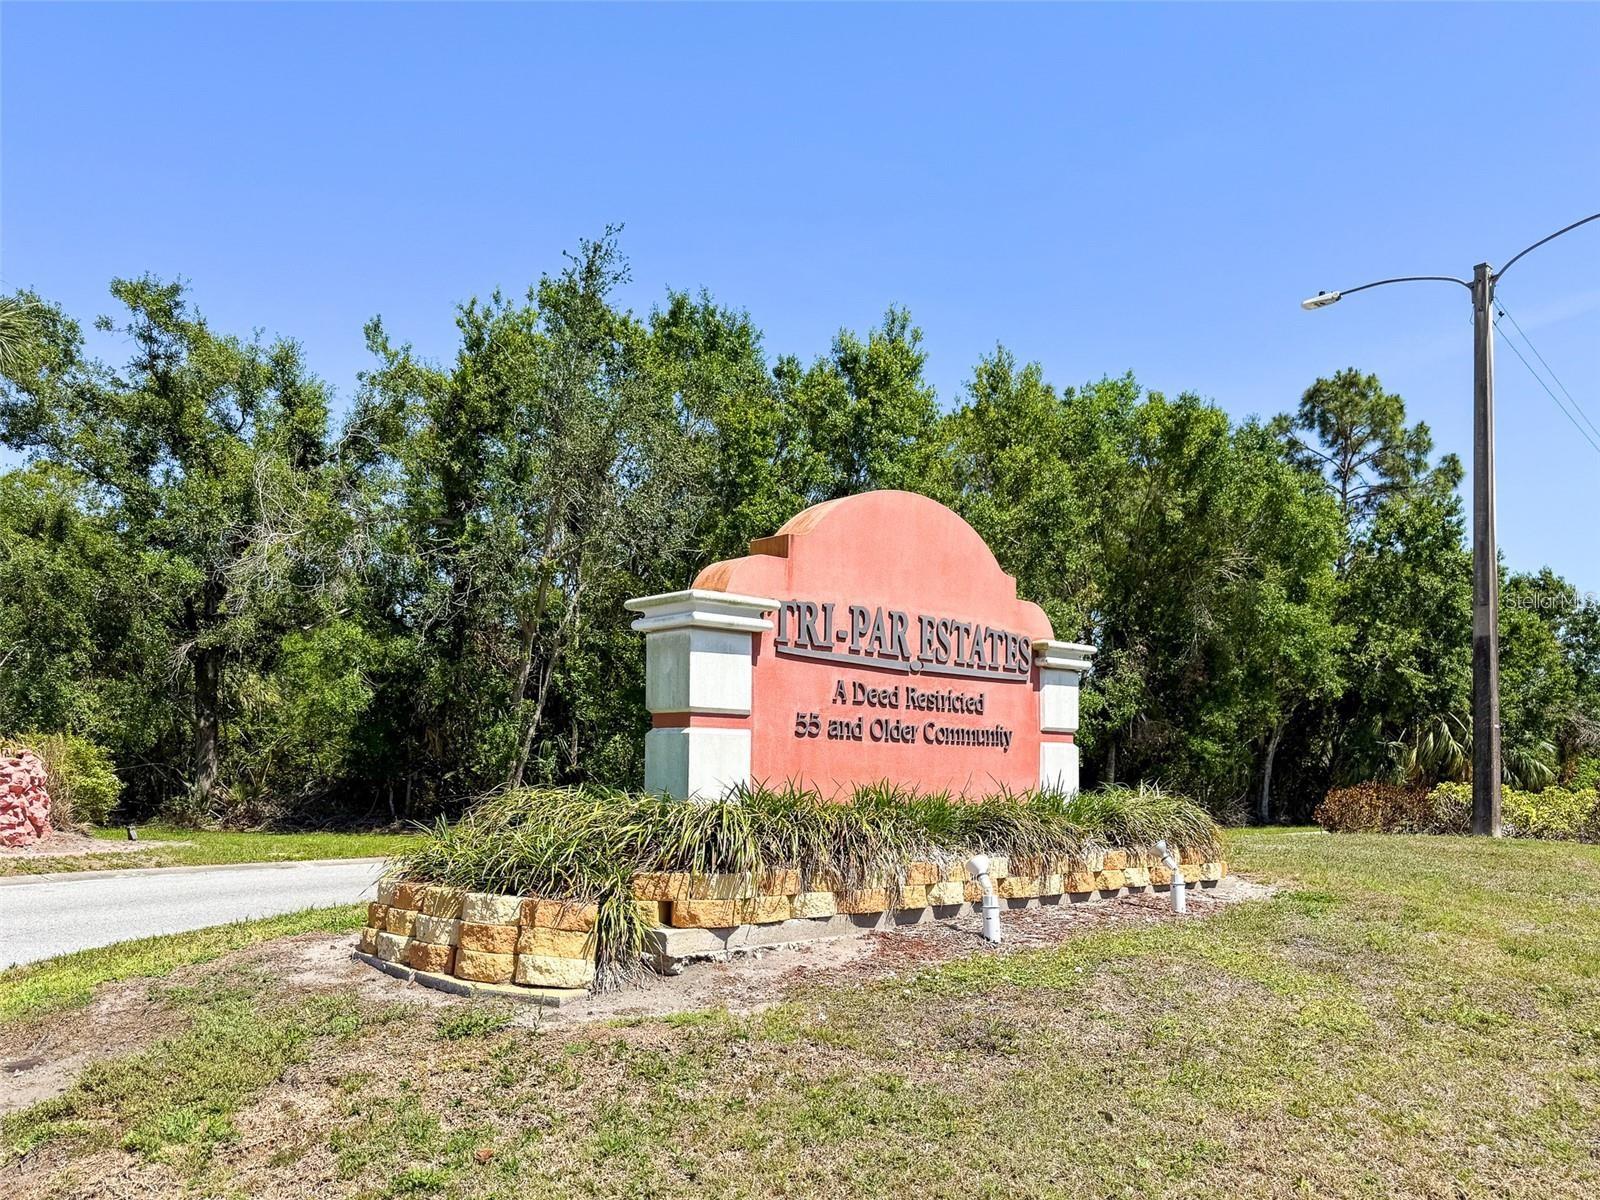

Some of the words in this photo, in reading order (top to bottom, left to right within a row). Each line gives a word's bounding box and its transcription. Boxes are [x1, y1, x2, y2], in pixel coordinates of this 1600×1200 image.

[775, 600, 911, 660] TRI-PAR
[917, 615, 1032, 674] ESTATES
[832, 680, 847, 705] A
[852, 681, 899, 708] Deed
[906, 687, 985, 715] Restricted
[795, 713, 821, 738] 55
[828, 717, 863, 741] and
[870, 719, 917, 745] Older
[924, 722, 1012, 753] Community
